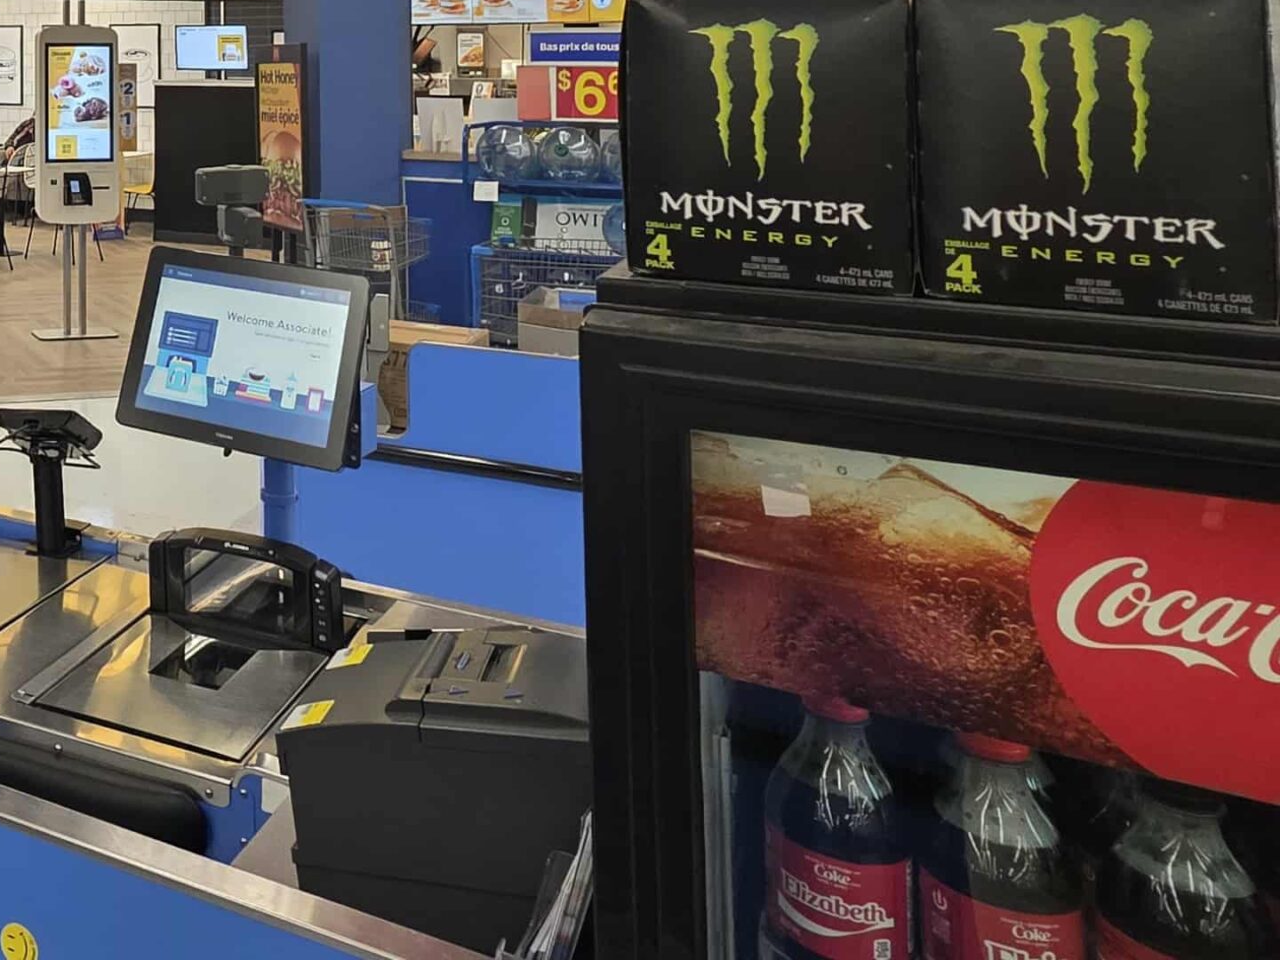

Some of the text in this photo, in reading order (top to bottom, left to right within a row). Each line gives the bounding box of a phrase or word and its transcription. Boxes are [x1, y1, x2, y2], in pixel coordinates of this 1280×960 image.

[539, 41, 619, 53] Bas prix de tous
[659, 189, 873, 230] MONSTER
[690, 226, 840, 248] ENERGY
[961, 203, 1226, 249] MONSTER
[646, 233, 672, 262] 4
[1000, 245, 1184, 269] ENERGY
[645, 258, 676, 270] PACK
[946, 254, 977, 284] 4
[945, 281, 982, 294] PACK
[1164, 299, 1208, 313] CANETTES
[226, 310, 333, 337] Welcome Associate!
[813, 862, 852, 885] Coke
[781, 866, 887, 924] Elizabeth
[1011, 924, 1053, 942] Coke
